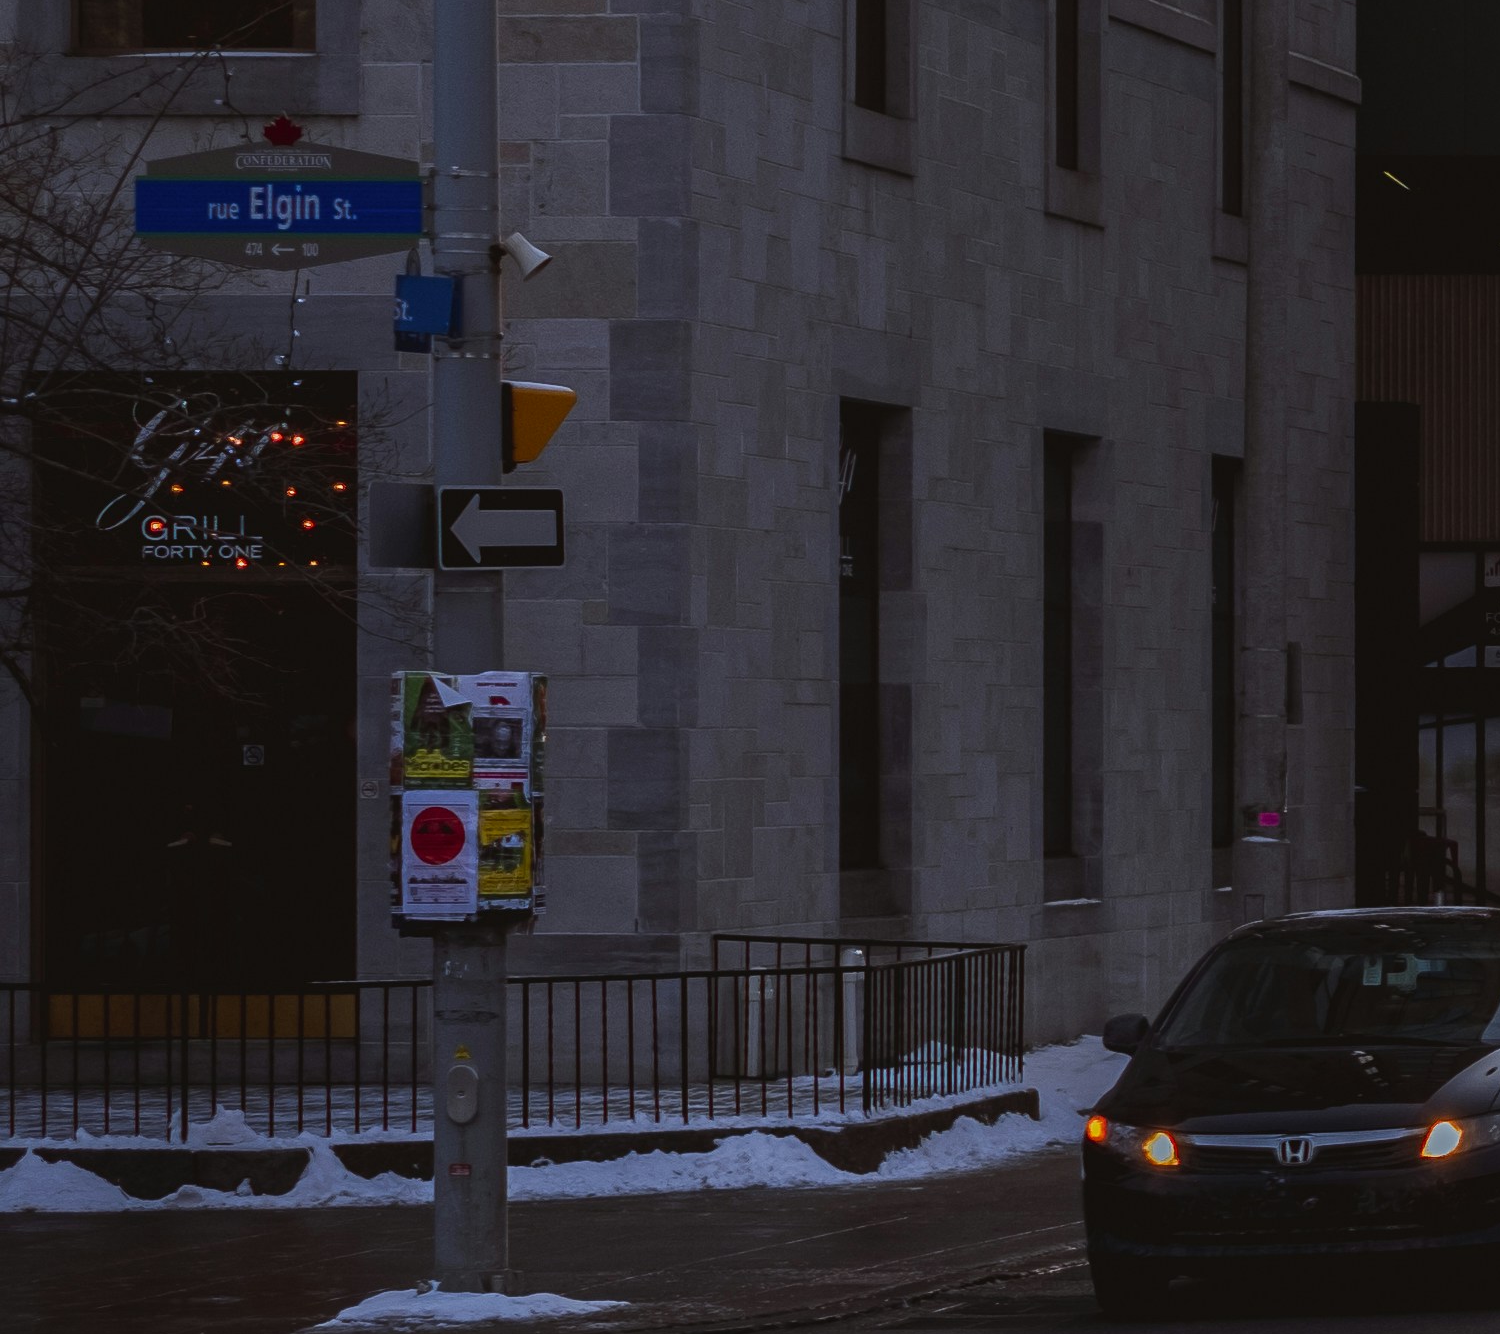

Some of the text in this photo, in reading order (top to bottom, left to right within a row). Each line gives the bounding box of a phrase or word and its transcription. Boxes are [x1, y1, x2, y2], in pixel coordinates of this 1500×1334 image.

[235, 154, 332, 169] CONFEDERATION
[207, 184, 358, 230] rue Elgin St.
[245, 243, 319, 257] 474 100
[141, 515, 264, 541] GRILL
[142, 545, 263, 559] FORTY ONE
